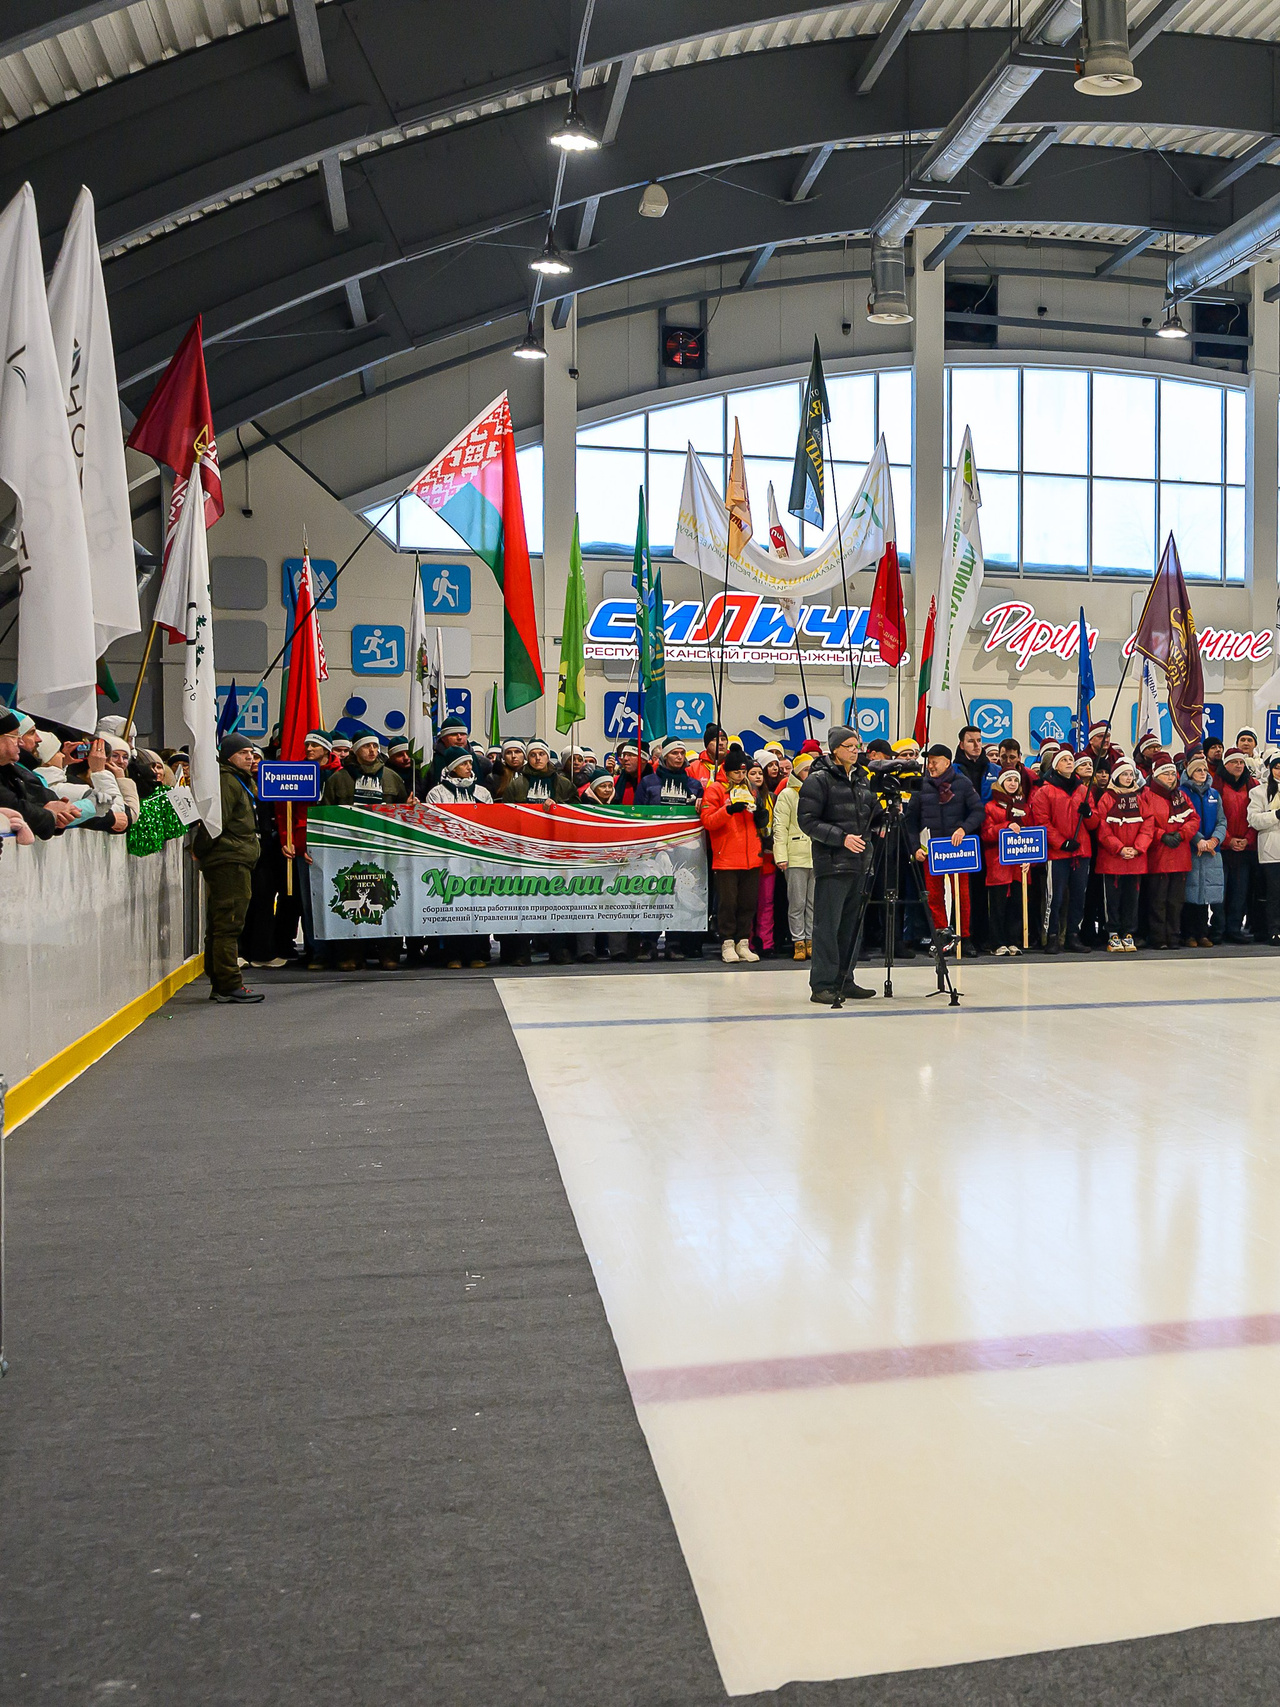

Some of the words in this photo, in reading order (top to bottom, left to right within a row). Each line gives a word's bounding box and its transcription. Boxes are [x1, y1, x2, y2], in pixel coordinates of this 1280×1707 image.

[743, 651, 859, 664] ГОРНОЛЫЖНЫЙ
[993, 716, 1010, 728] 24
[265, 771, 314, 782] Хранители
[280, 783, 299, 791] леса
[934, 849, 975, 861] Агрохолдинг
[344, 873, 387, 881] ХРАНИТЕЛИ
[421, 868, 604, 904] Хранители
[606, 875, 675, 896] леса
[422, 905, 454, 914] сборная
[455, 905, 486, 913] команда
[487, 904, 529, 913] работников
[530, 904, 598, 912] природоохранных
[604, 903, 675, 911] лесохозяйственных
[422, 915, 471, 924] учреждений
[473, 914, 519, 922] Управления
[550, 913, 595, 922] Президента
[597, 912, 640, 921] Республики
[643, 912, 674, 921] Беларусь
